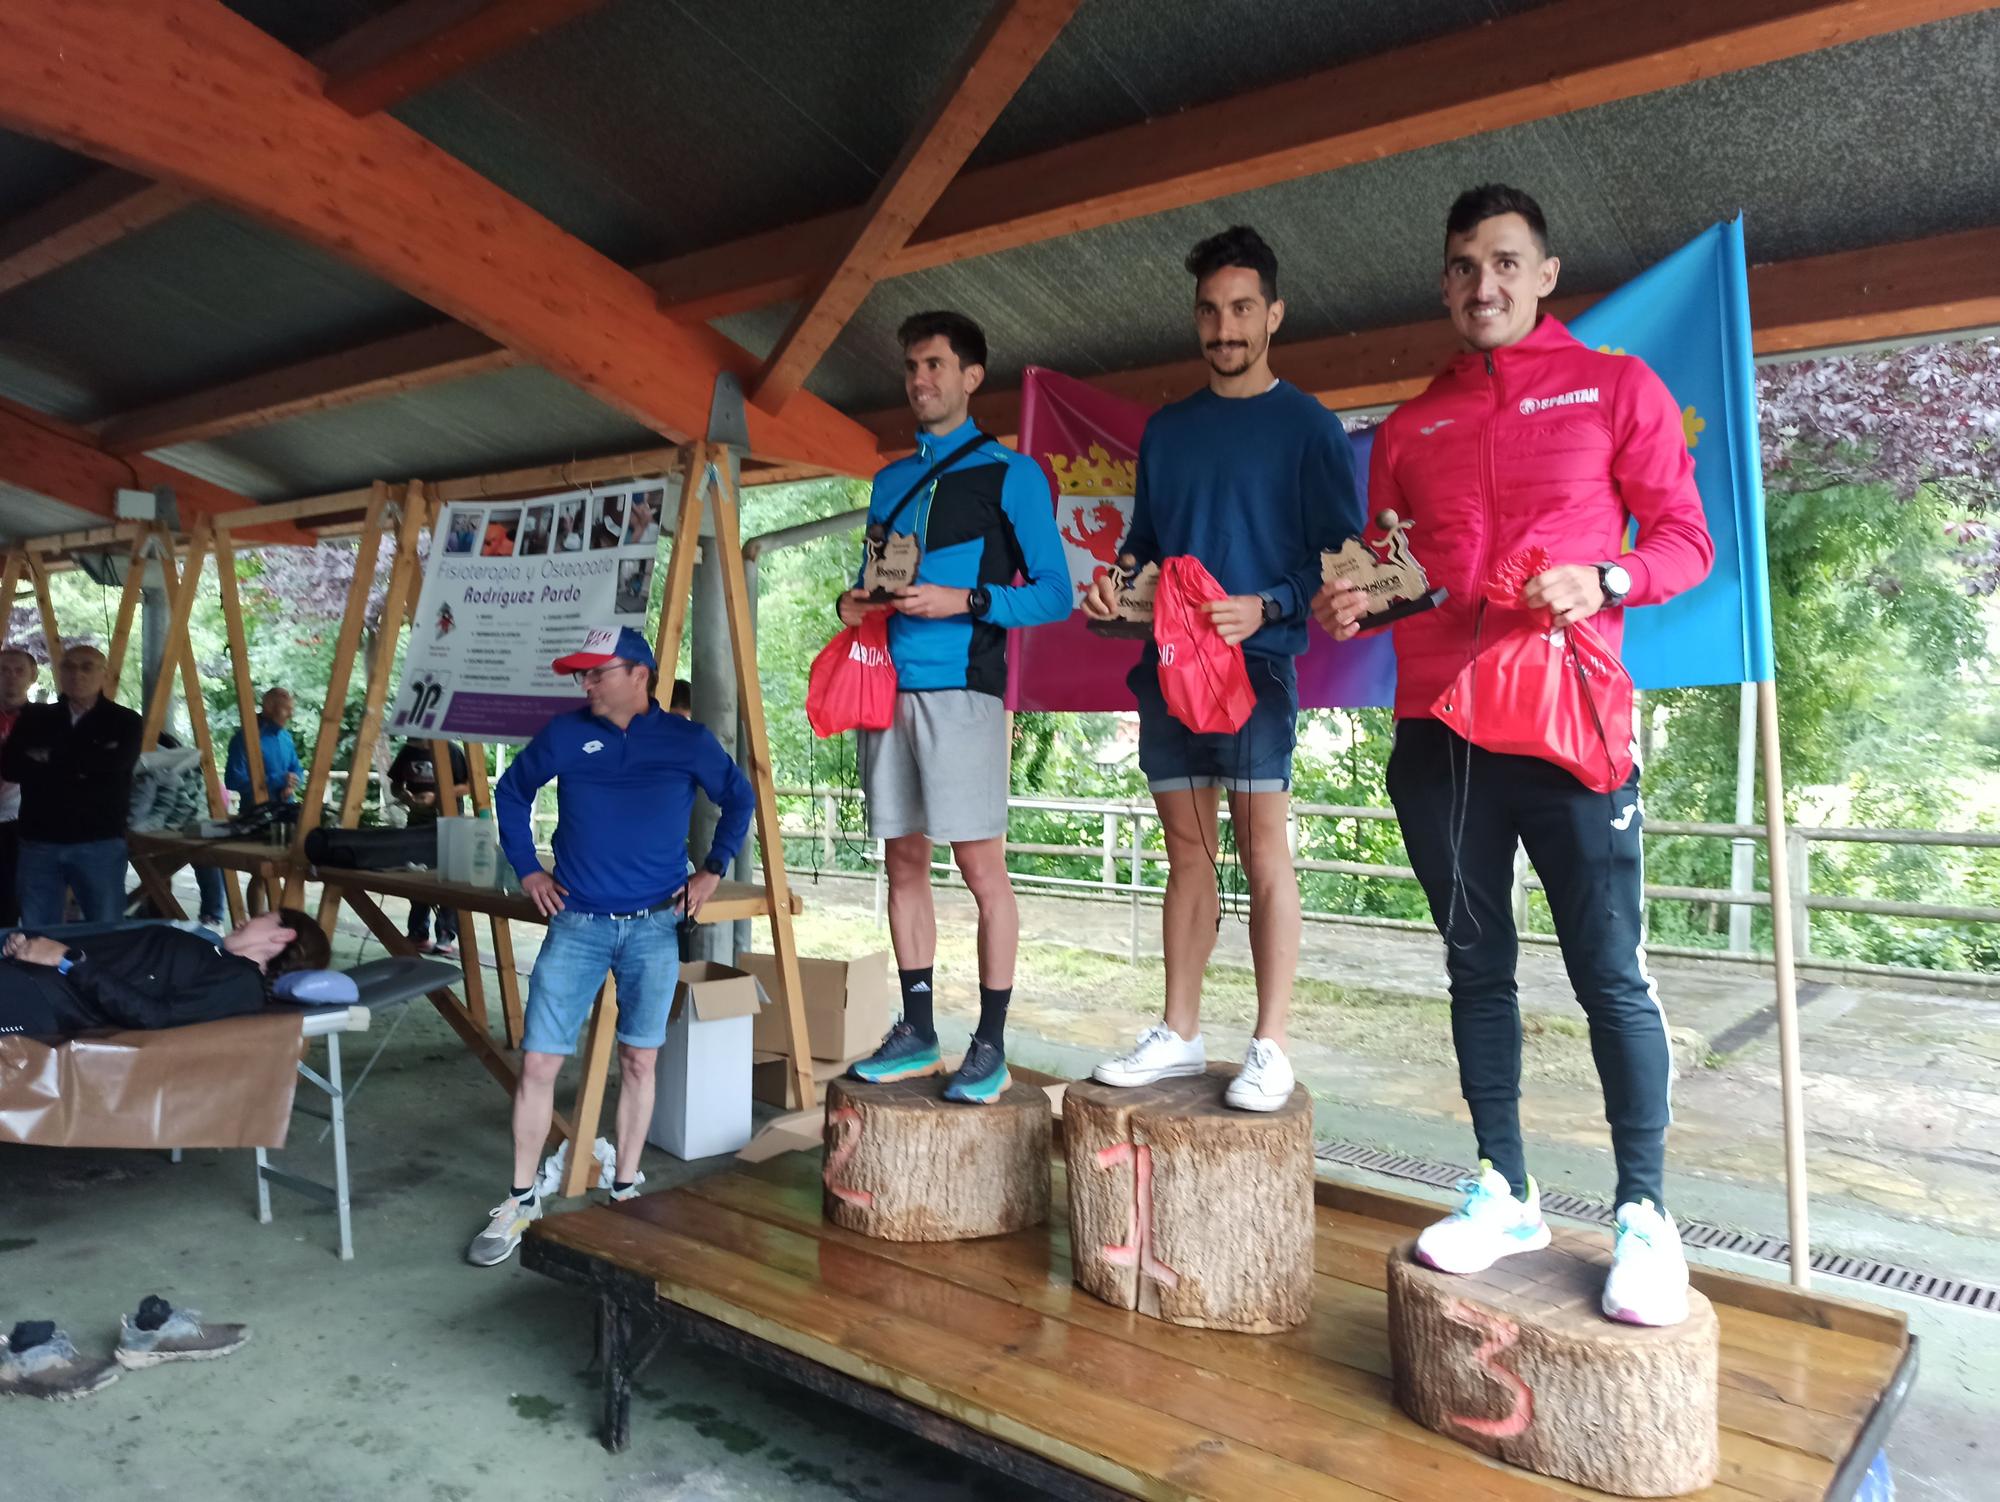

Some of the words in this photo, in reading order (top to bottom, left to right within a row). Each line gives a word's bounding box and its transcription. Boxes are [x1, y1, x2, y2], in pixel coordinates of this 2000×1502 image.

[1541, 388, 1599, 410] SPARTAN
[438, 561, 521, 583] Fisioterapia
[540, 584, 582, 603] Pardo
[822, 1107, 874, 1208] 2
[1096, 1142, 1179, 1288] 1
[1442, 1298, 1535, 1437] 3
